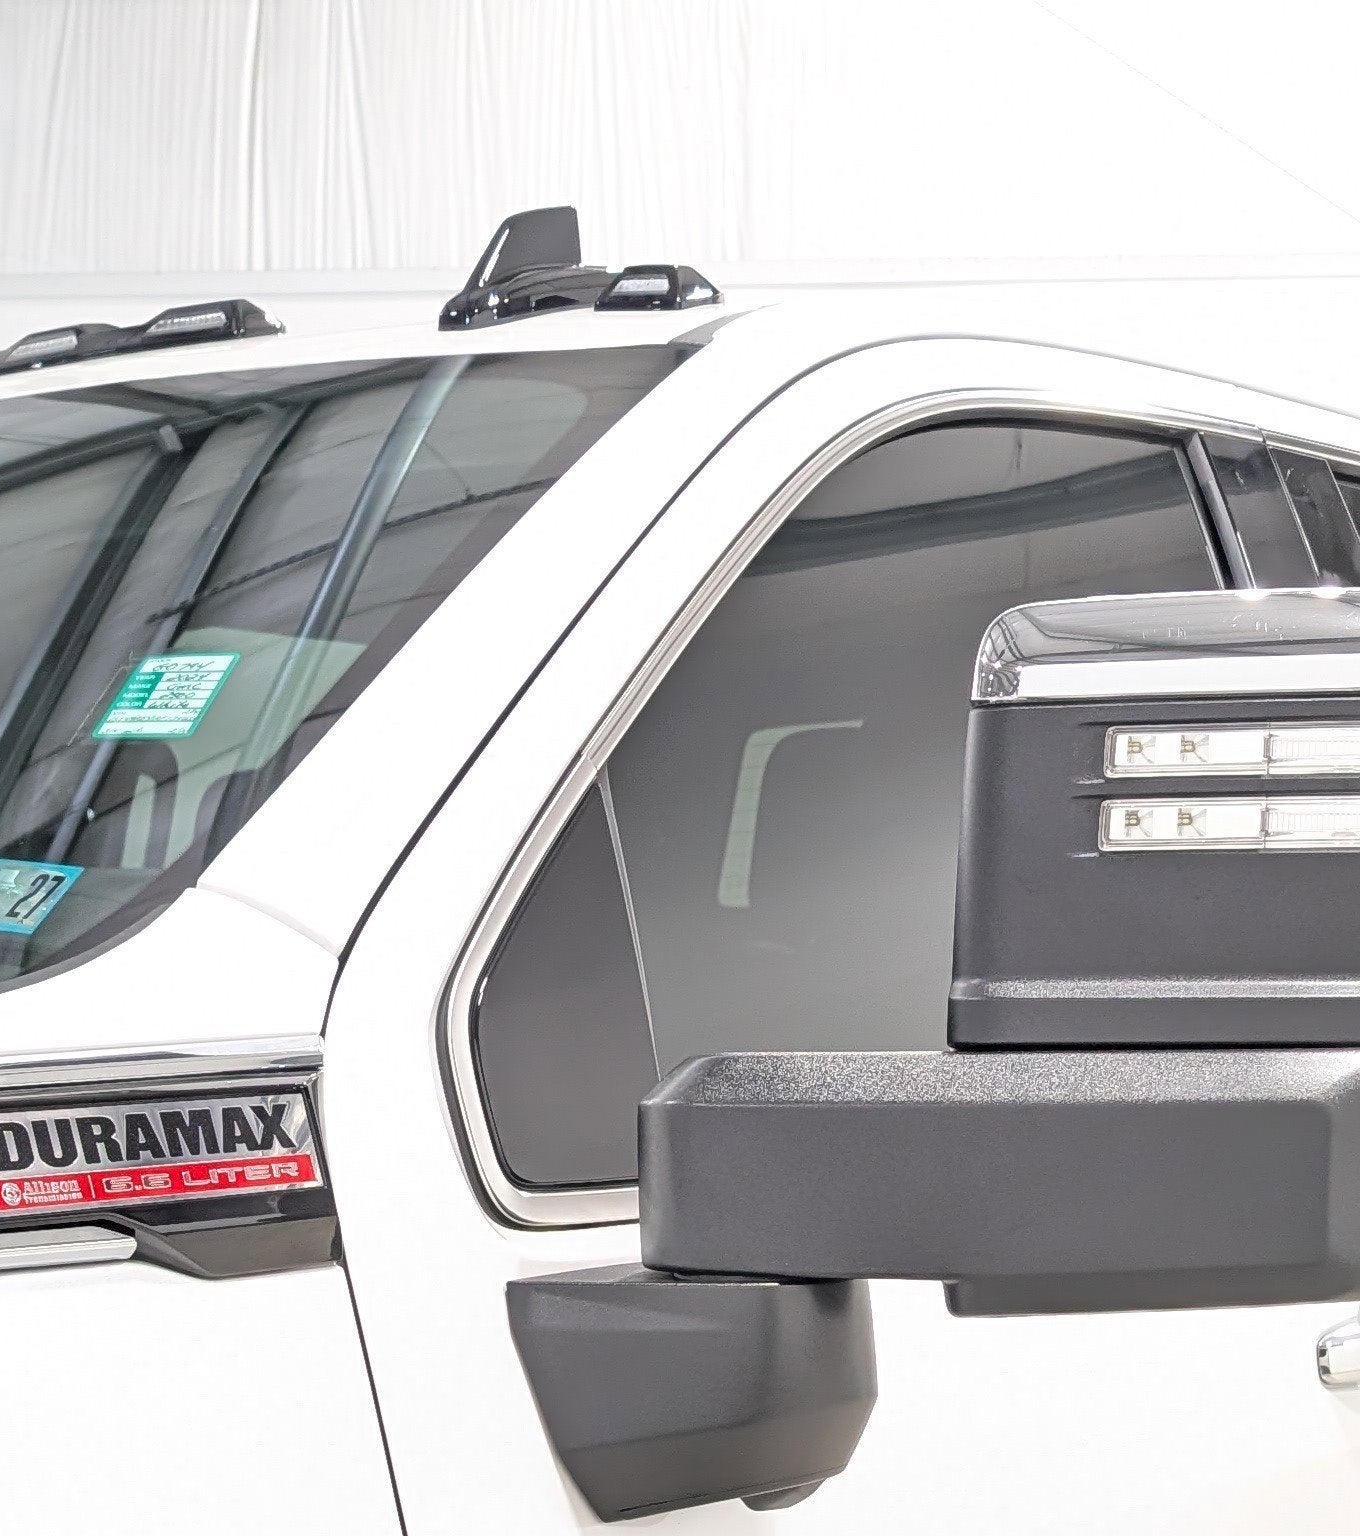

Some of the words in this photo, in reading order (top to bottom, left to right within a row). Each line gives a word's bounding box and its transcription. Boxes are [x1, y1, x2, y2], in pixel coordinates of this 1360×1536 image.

[5, 873, 67, 919] 27
[23, 1179, 82, 1196] Allison
[102, 1173, 171, 1193] 6.6
[182, 1161, 299, 1187] LITER
